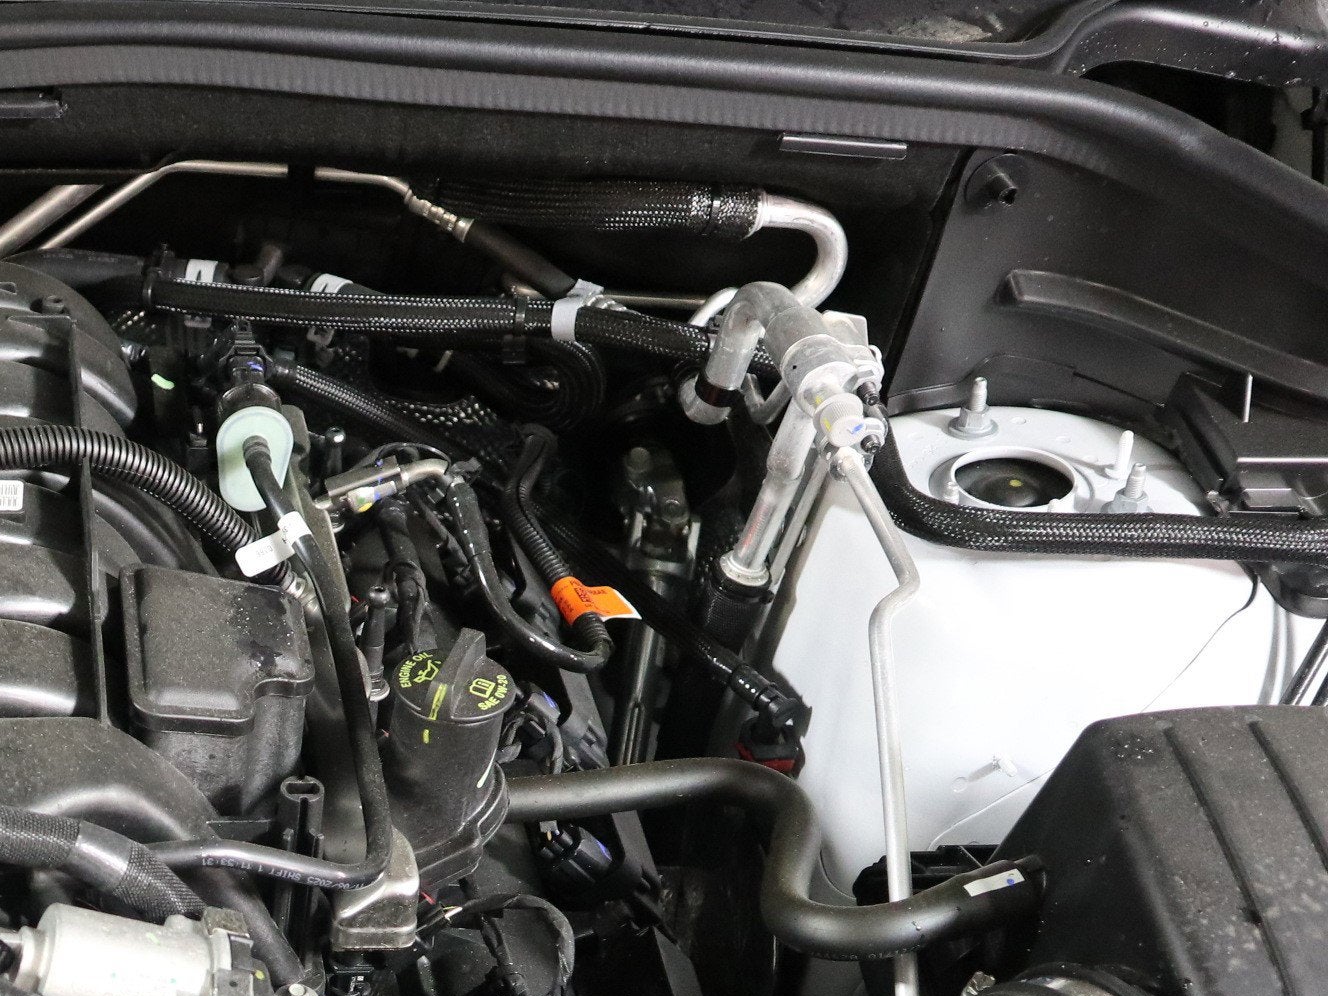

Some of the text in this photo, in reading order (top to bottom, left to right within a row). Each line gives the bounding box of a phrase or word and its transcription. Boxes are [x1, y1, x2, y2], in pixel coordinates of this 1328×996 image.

[399, 652, 433, 688] ENGINE OIL
[477, 696, 500, 710] SAE
[269, 867, 302, 881] SHIFT
